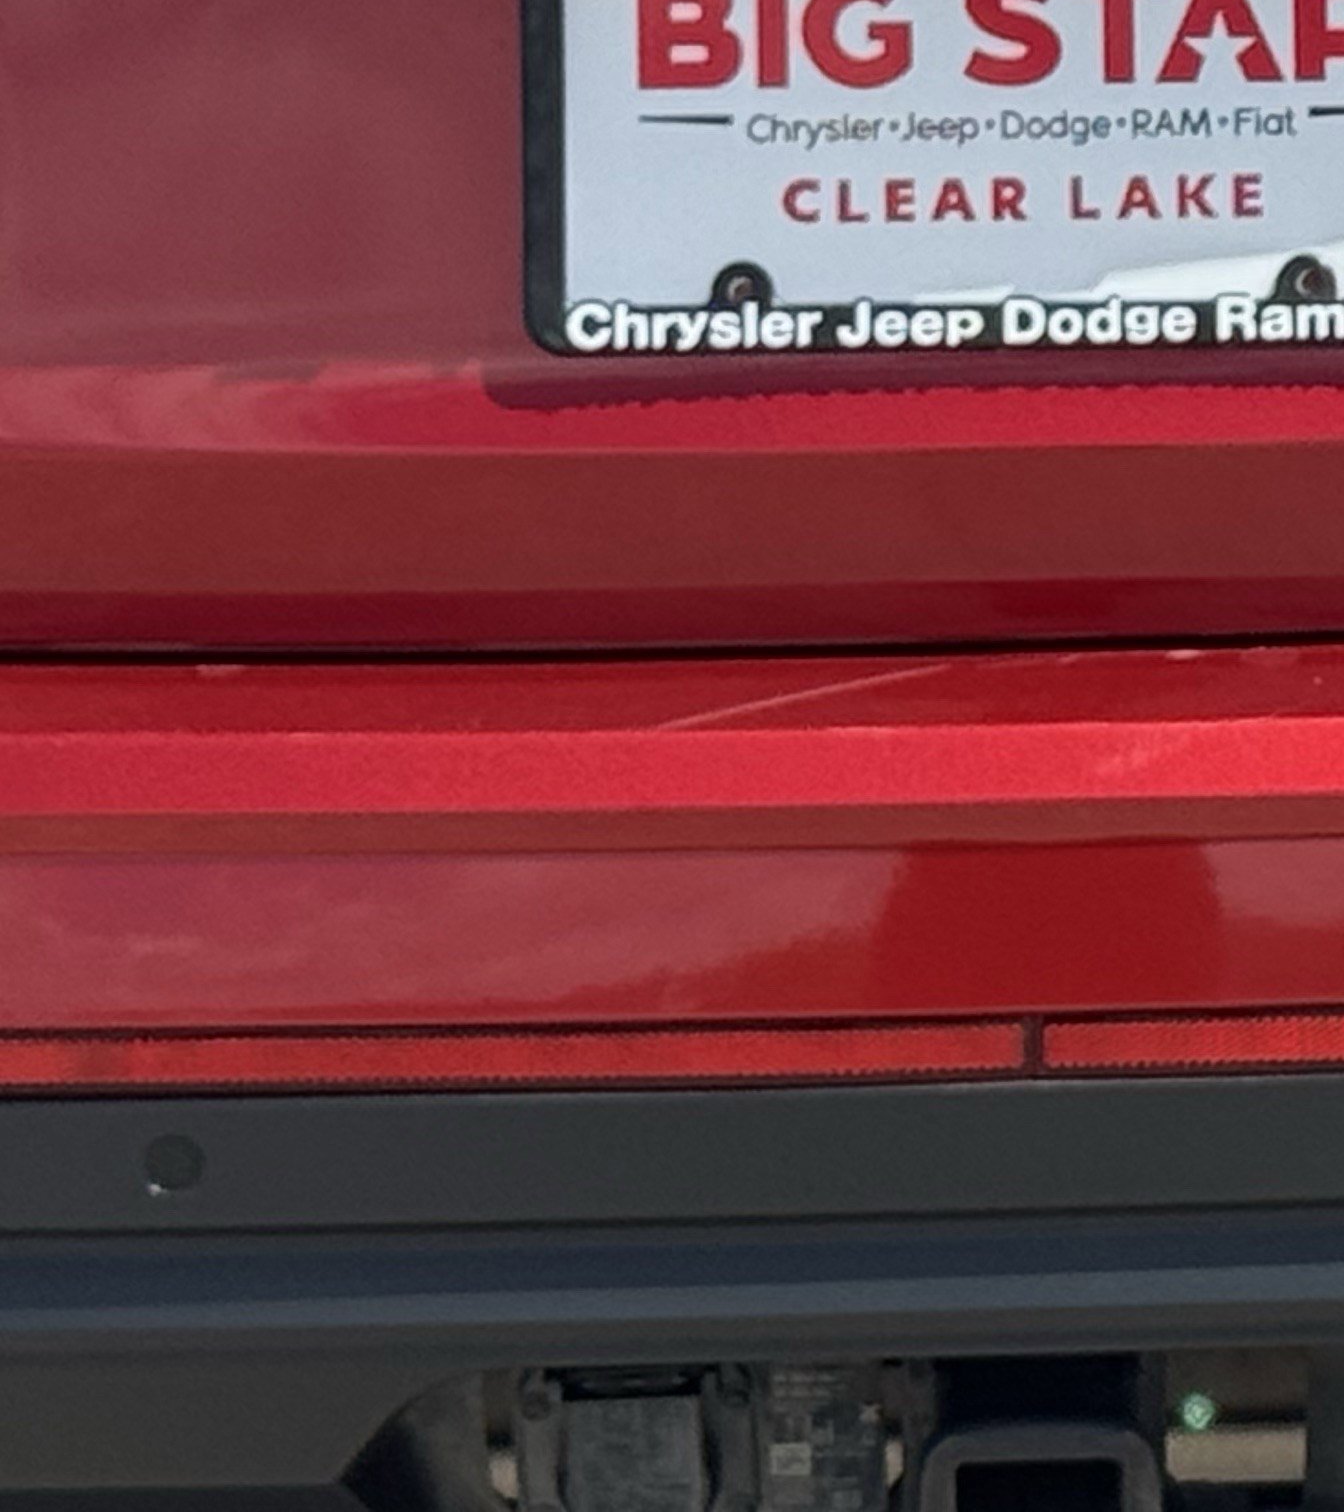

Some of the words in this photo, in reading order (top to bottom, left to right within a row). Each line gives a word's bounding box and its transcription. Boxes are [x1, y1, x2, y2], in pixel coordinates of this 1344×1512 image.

[782, 176, 1028, 223] CLEAR
[1070, 172, 1265, 220] LAKE
[565, 299, 823, 352] Chrysler
[836, 298, 985, 348] Jeep
[1002, 296, 1197, 345] Dodge
